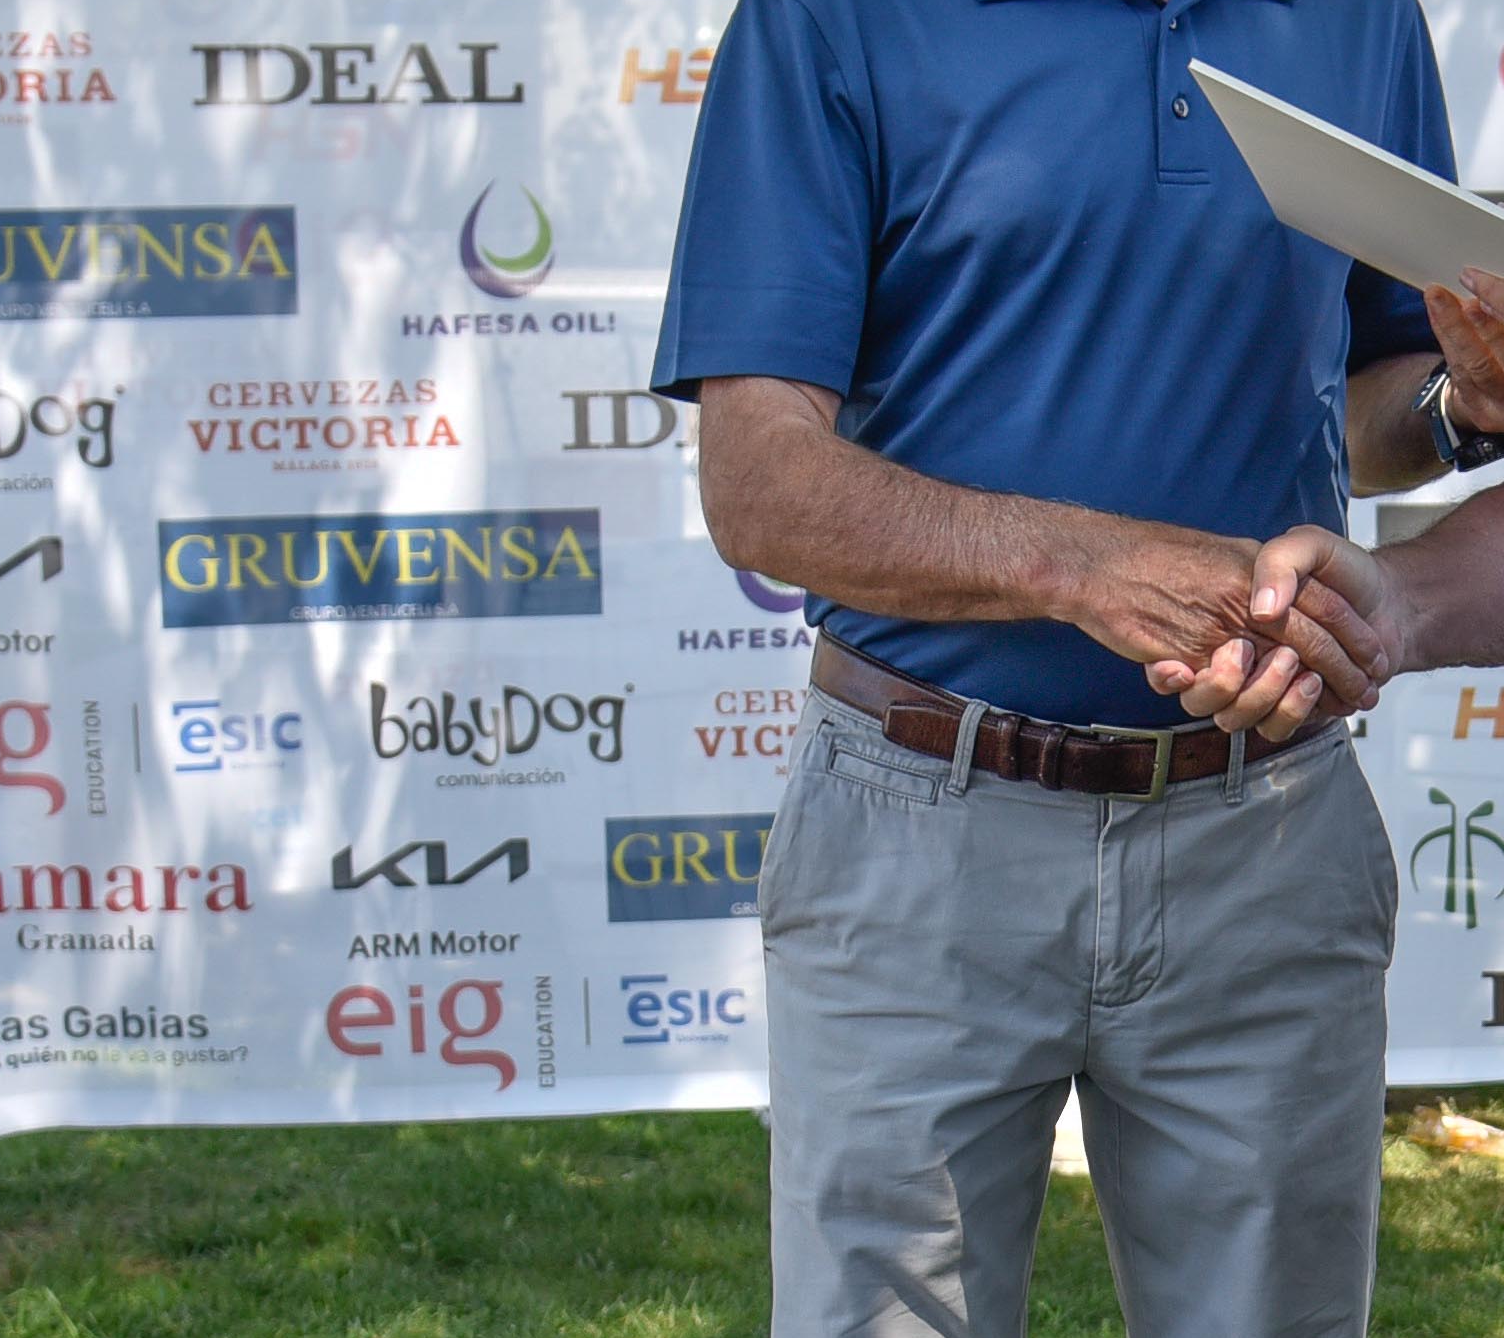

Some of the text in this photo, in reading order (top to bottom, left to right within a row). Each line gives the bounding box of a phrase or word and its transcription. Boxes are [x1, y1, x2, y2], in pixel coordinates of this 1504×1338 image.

[191, 42, 525, 106] IDEAL
[401, 311, 616, 337] HAFESA OIL!
[207, 378, 438, 409] CERVEZAS
[187, 414, 461, 453] VICTORIA
[561, 389, 695, 451] ID
[164, 524, 597, 595] GRUVENSA
[677, 627, 813, 651] HAFESA
[714, 688, 807, 715] CER
[82, 699, 107, 817] EDUCATION
[693, 724, 797, 759] VIC
[434, 767, 567, 790] comunicación
[331, 837, 530, 890] KIA
[16, 923, 157, 953] Granada
[347, 929, 522, 960] ARM Motor
[62, 1005, 211, 1041] Gabias
[326, 977, 517, 1092] eig
[537, 975, 556, 1089] EDUCATION
[5, 1044, 67, 1070] quién
[70, 1045, 100, 1063] no
[171, 1044, 249, 1067] gustar?
